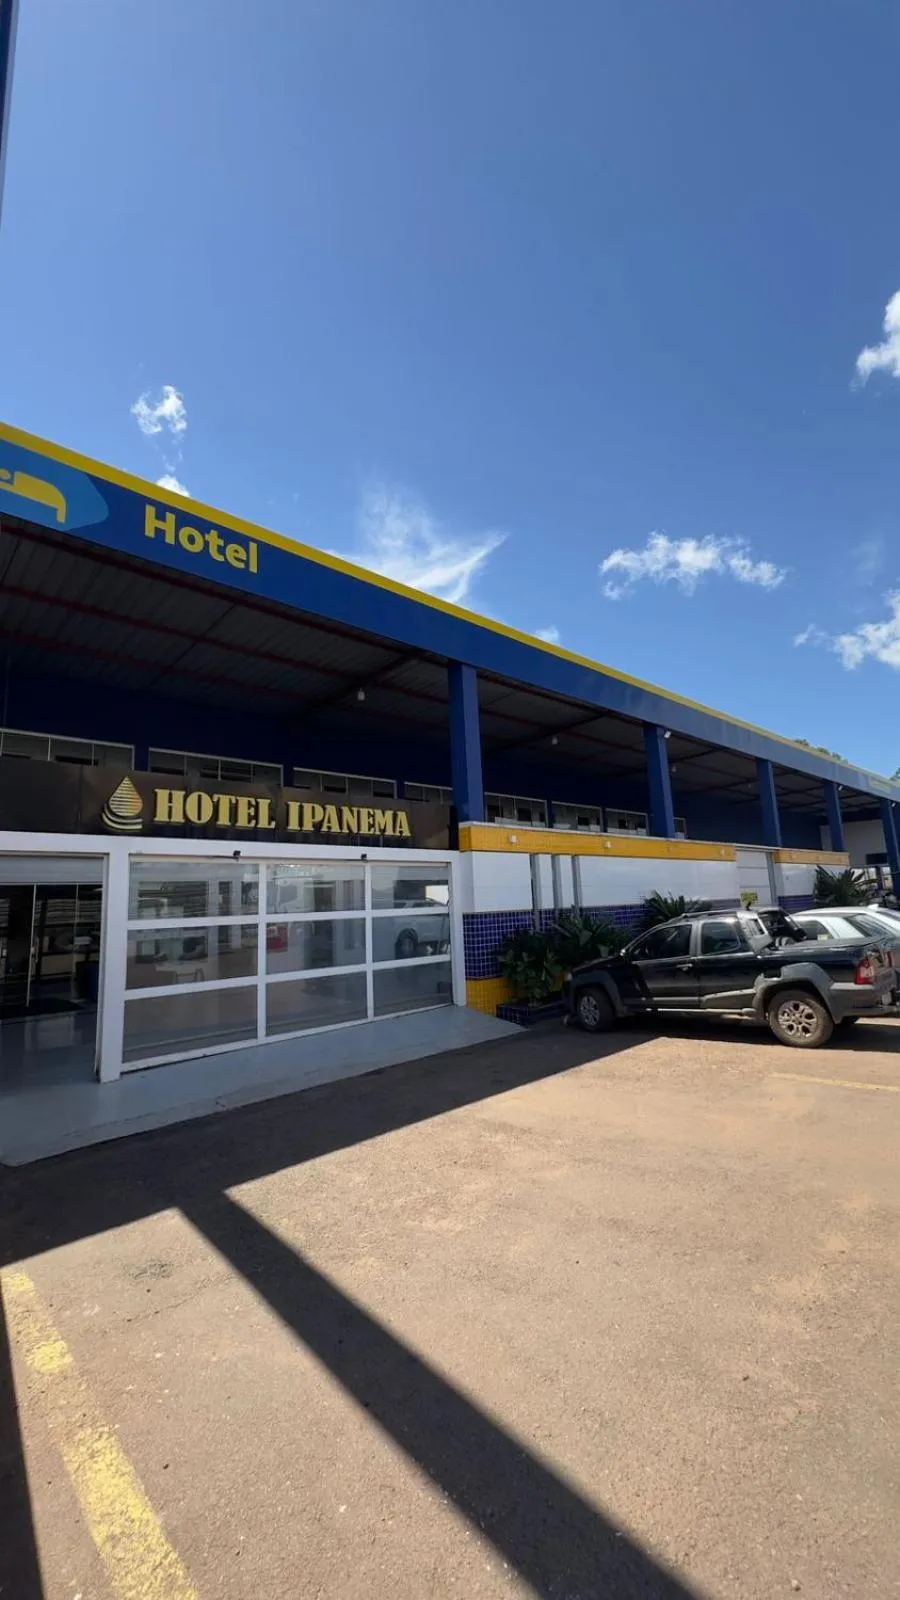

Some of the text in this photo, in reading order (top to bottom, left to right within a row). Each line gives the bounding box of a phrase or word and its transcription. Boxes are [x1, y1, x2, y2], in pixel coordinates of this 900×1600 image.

[144, 505, 258, 573] Hotel
[154, 788, 411, 837] HOTEL IPANEMA
